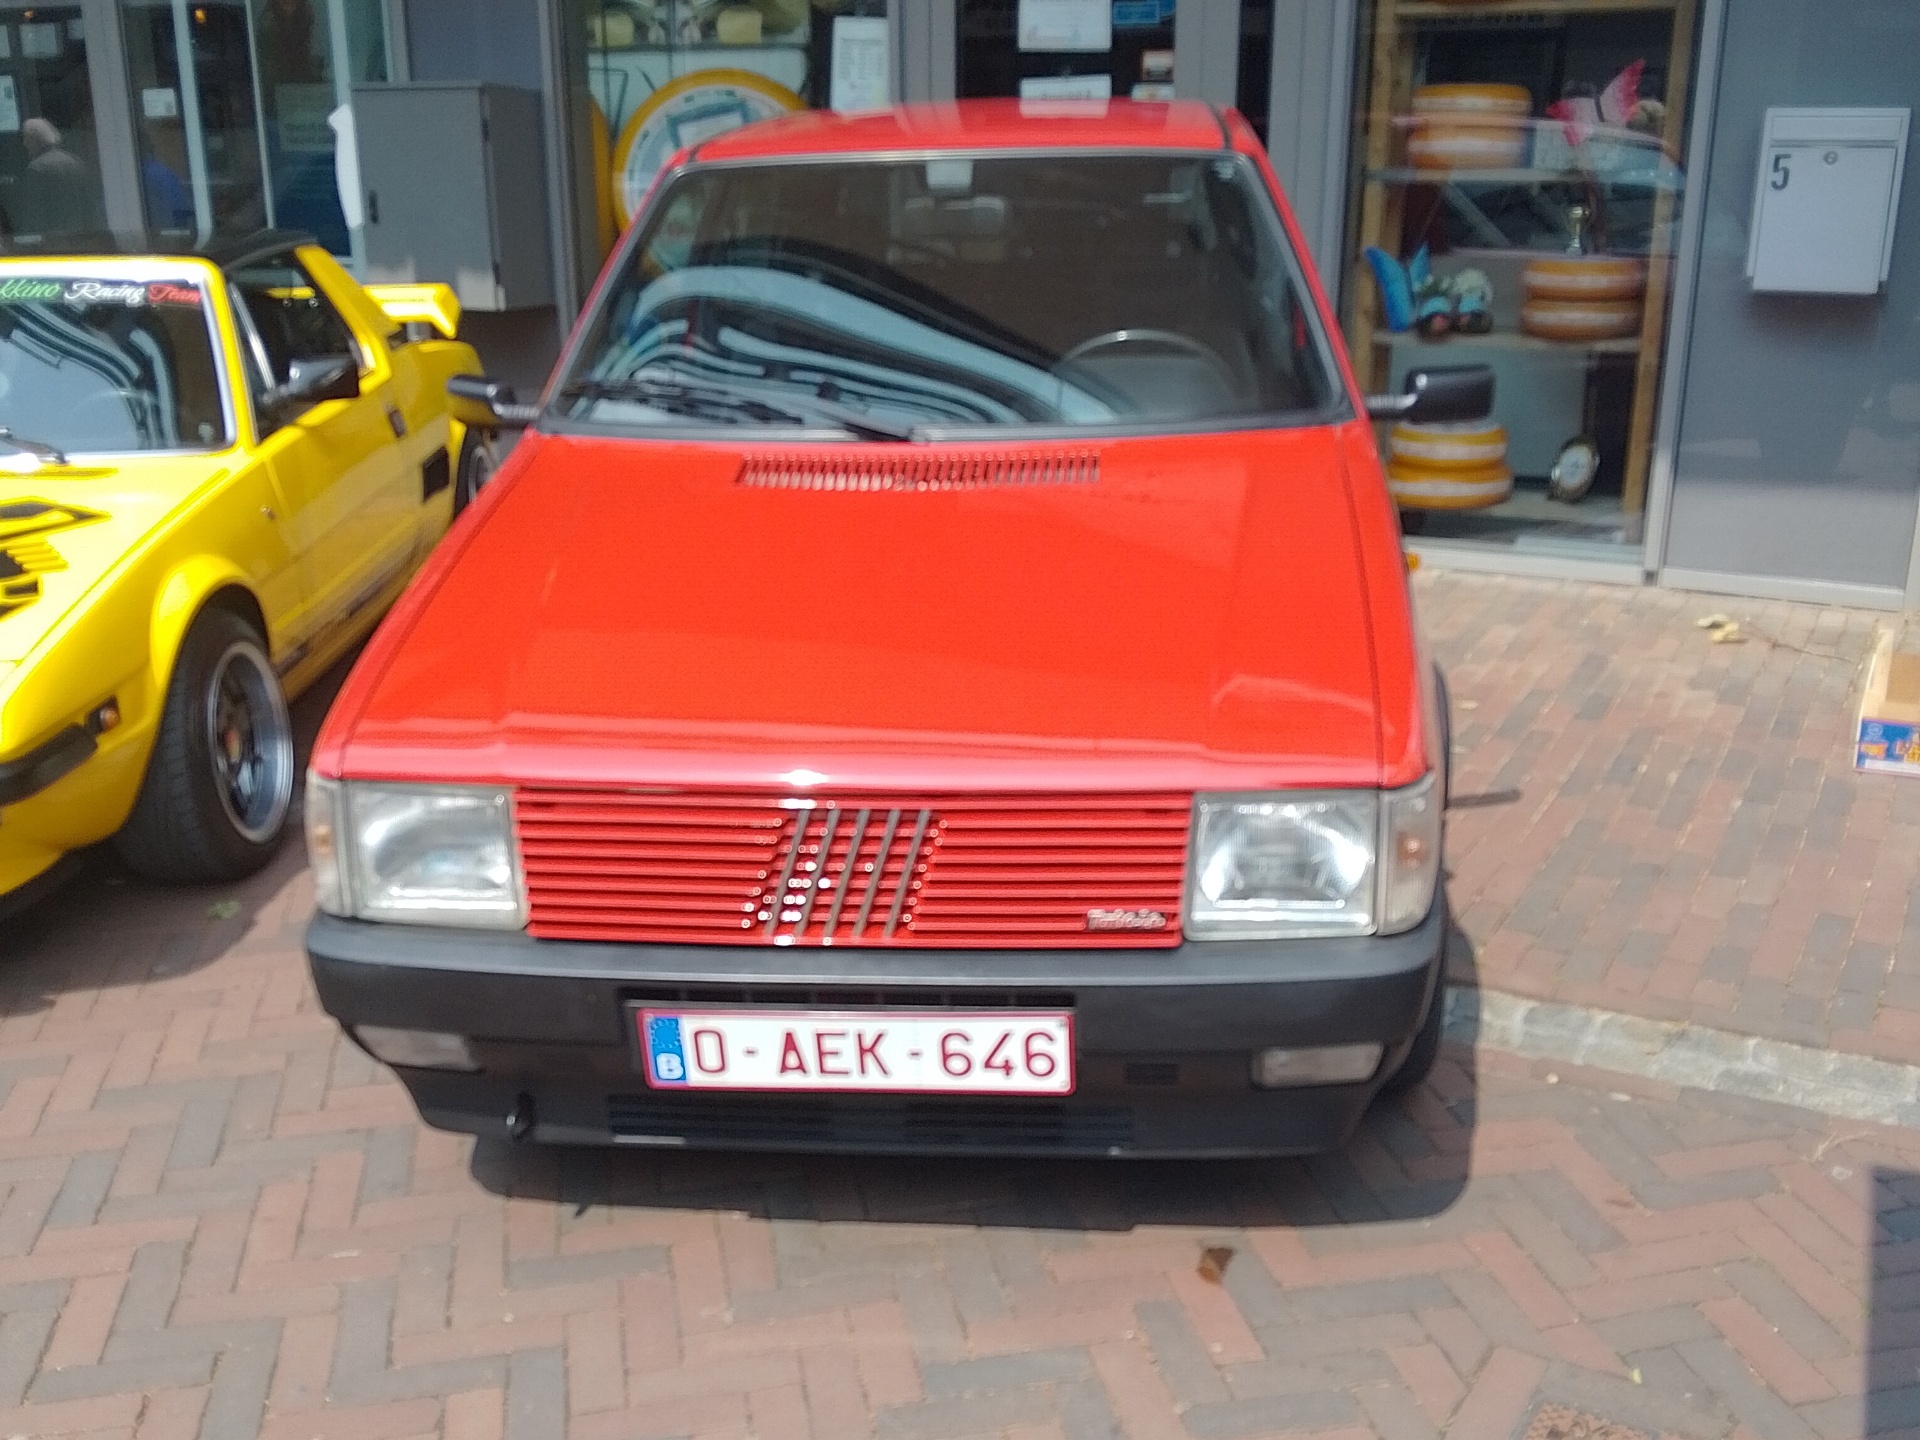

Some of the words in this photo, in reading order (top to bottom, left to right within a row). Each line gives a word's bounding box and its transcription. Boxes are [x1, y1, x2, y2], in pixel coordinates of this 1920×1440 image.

[1771, 153, 1793, 191] 5
[65, 281, 145, 304] Racing
[148, 283, 201, 303] Team
